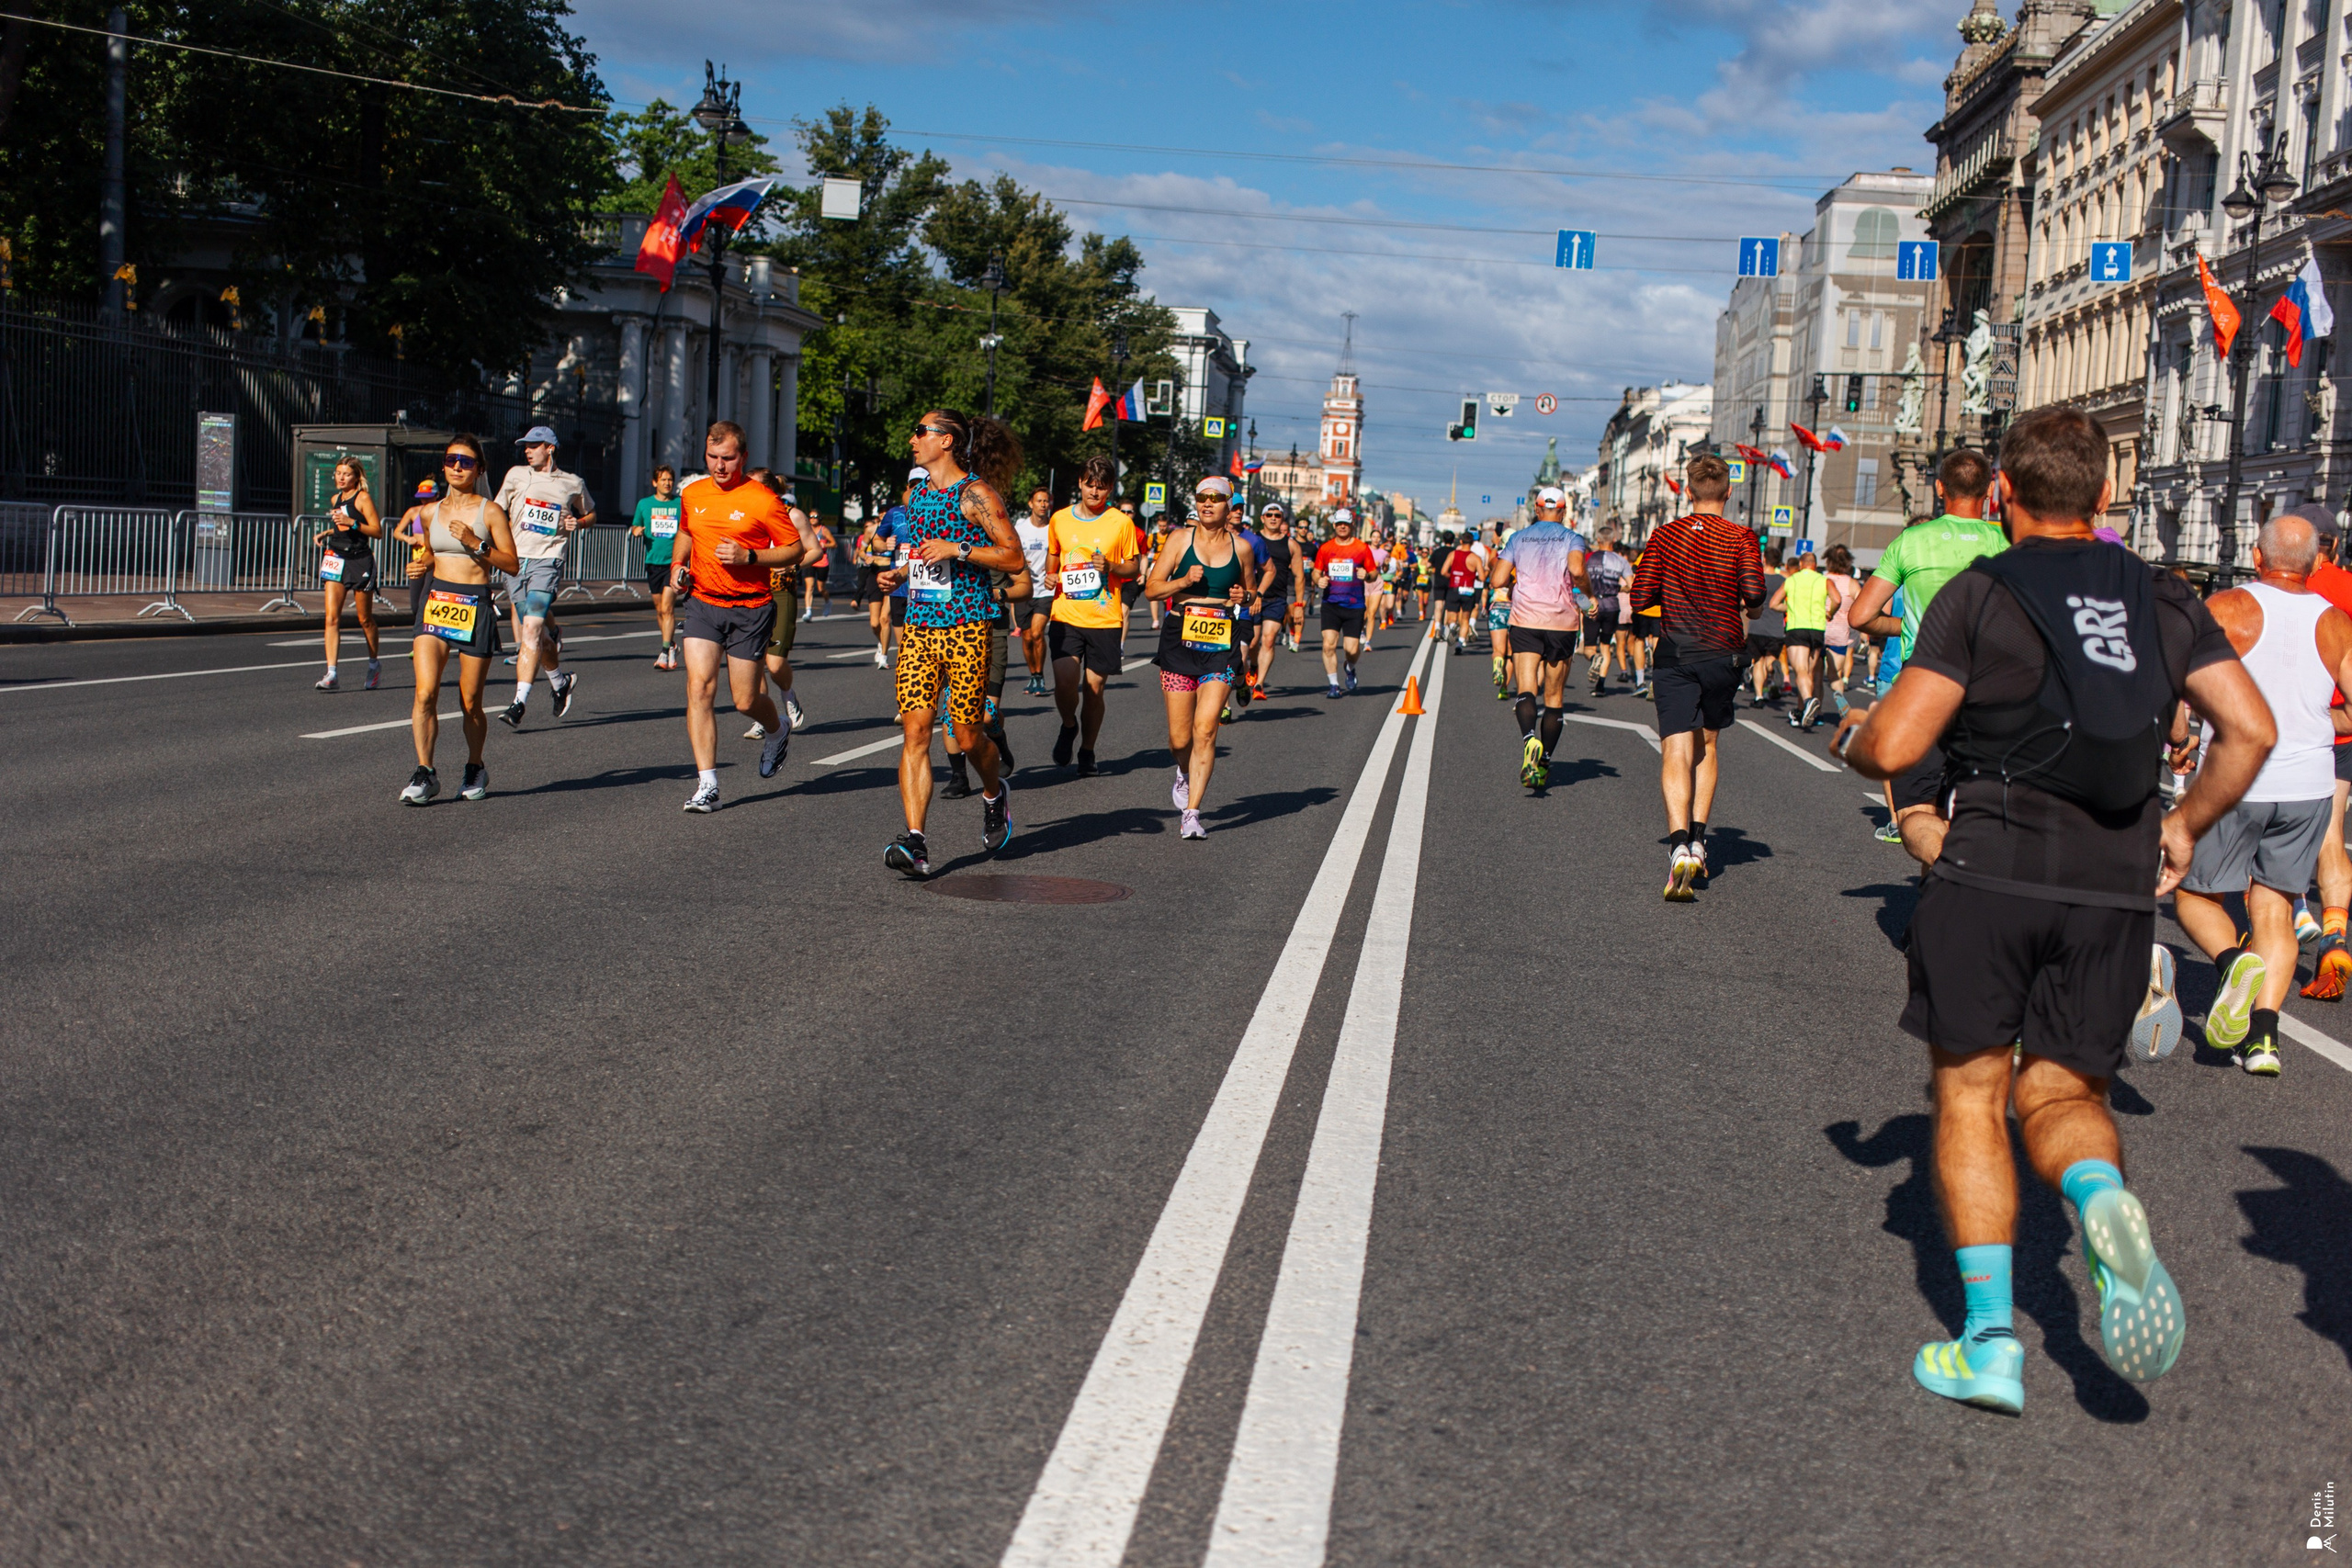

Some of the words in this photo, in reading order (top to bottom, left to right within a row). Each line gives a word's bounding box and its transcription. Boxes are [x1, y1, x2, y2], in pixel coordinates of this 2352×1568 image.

[527, 508, 554, 523] 6186
[655, 521, 673, 529] 5554
[912, 563, 943, 581] 4919
[1067, 571, 1096, 586] 5619
[430, 604, 469, 623] 4920
[428, 625, 435, 633] D
[1190, 620, 1226, 636] 4025
